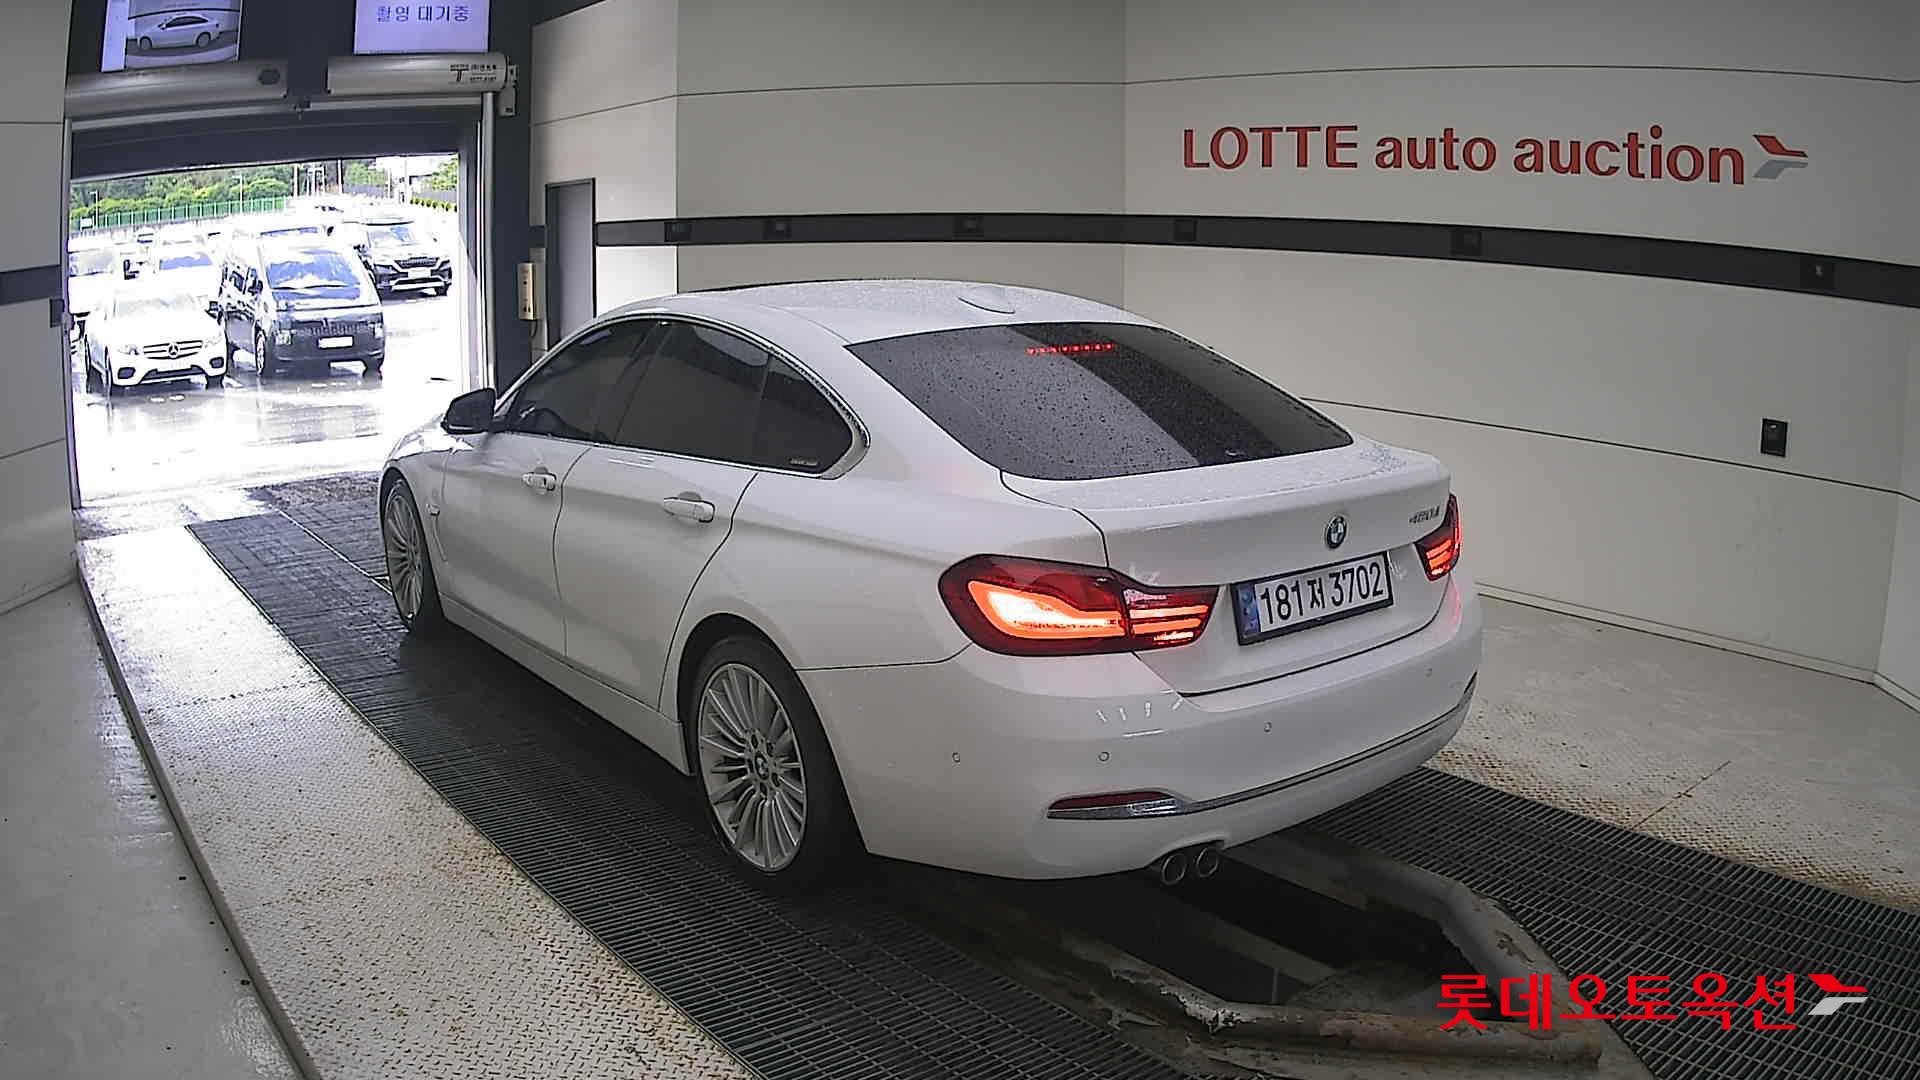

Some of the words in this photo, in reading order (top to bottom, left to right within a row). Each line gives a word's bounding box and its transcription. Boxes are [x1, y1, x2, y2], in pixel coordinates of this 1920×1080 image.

[418, 6, 468, 22] 대기중
[1183, 125, 1359, 169] LOTTE
[1375, 127, 1497, 171] auto
[1513, 124, 1745, 185] auction
